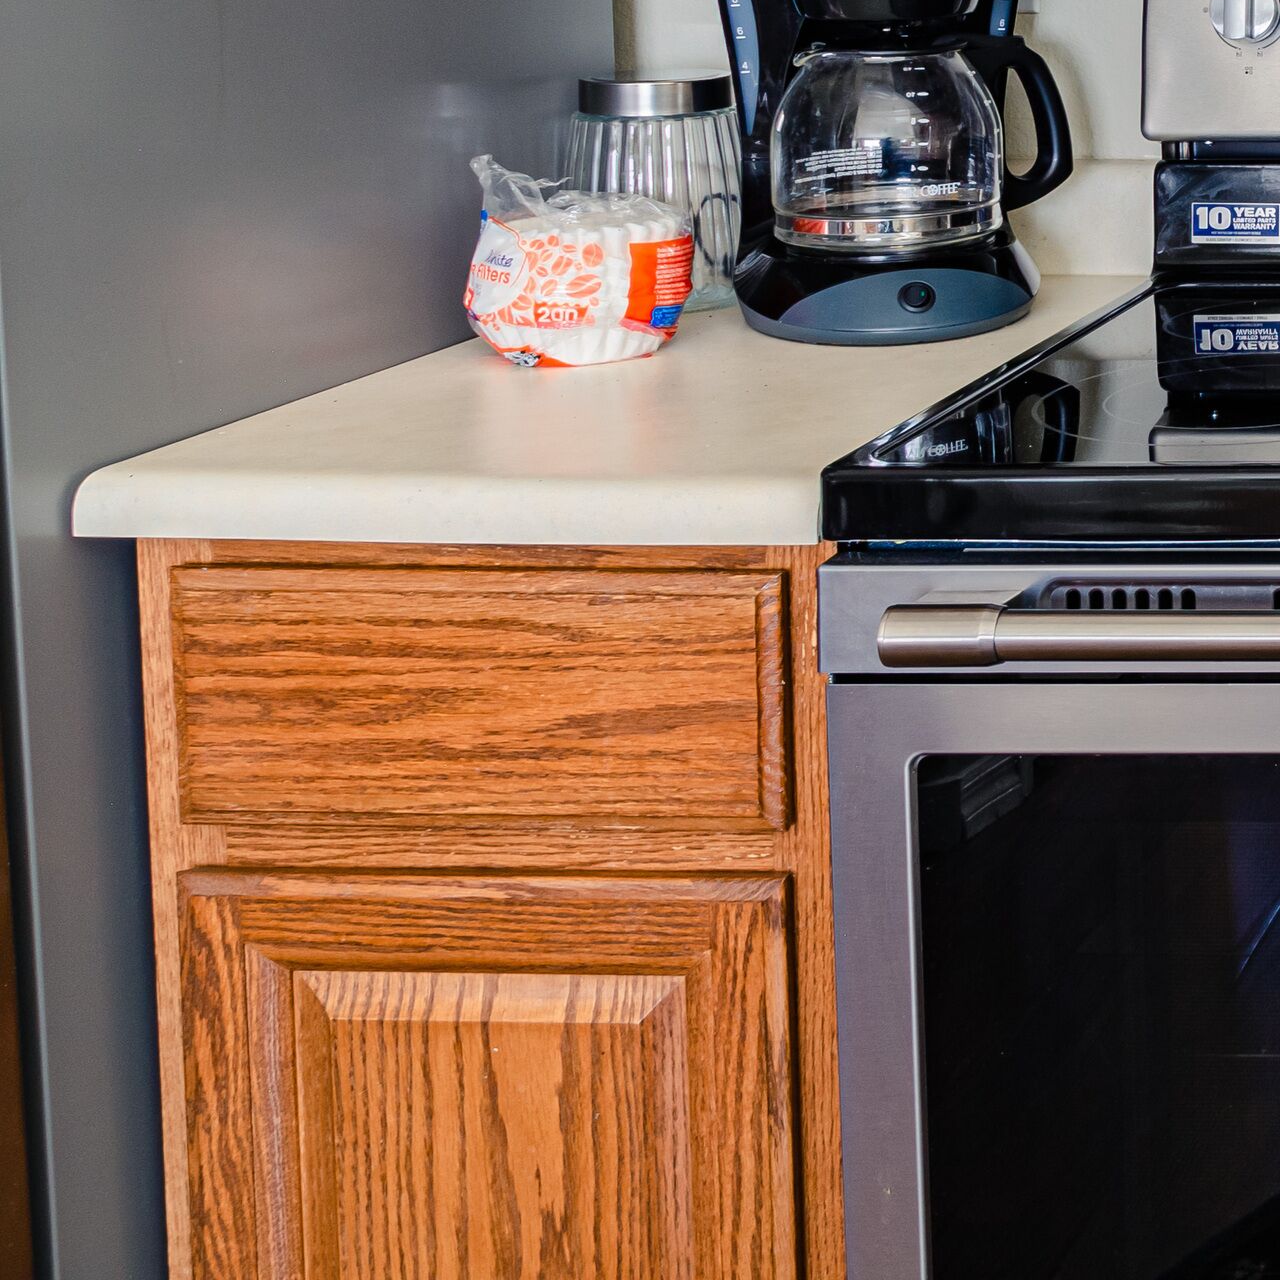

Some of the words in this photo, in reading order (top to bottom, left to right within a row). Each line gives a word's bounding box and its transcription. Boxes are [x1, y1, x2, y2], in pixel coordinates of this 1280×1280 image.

[999, 19, 1005, 27] 6
[736, 27, 743, 35] 6
[742, 61, 748, 70] 4
[921, 182, 960, 196] COFFEE
[1233, 207, 1276, 218] YEAR
[1196, 206, 1232, 230] 10
